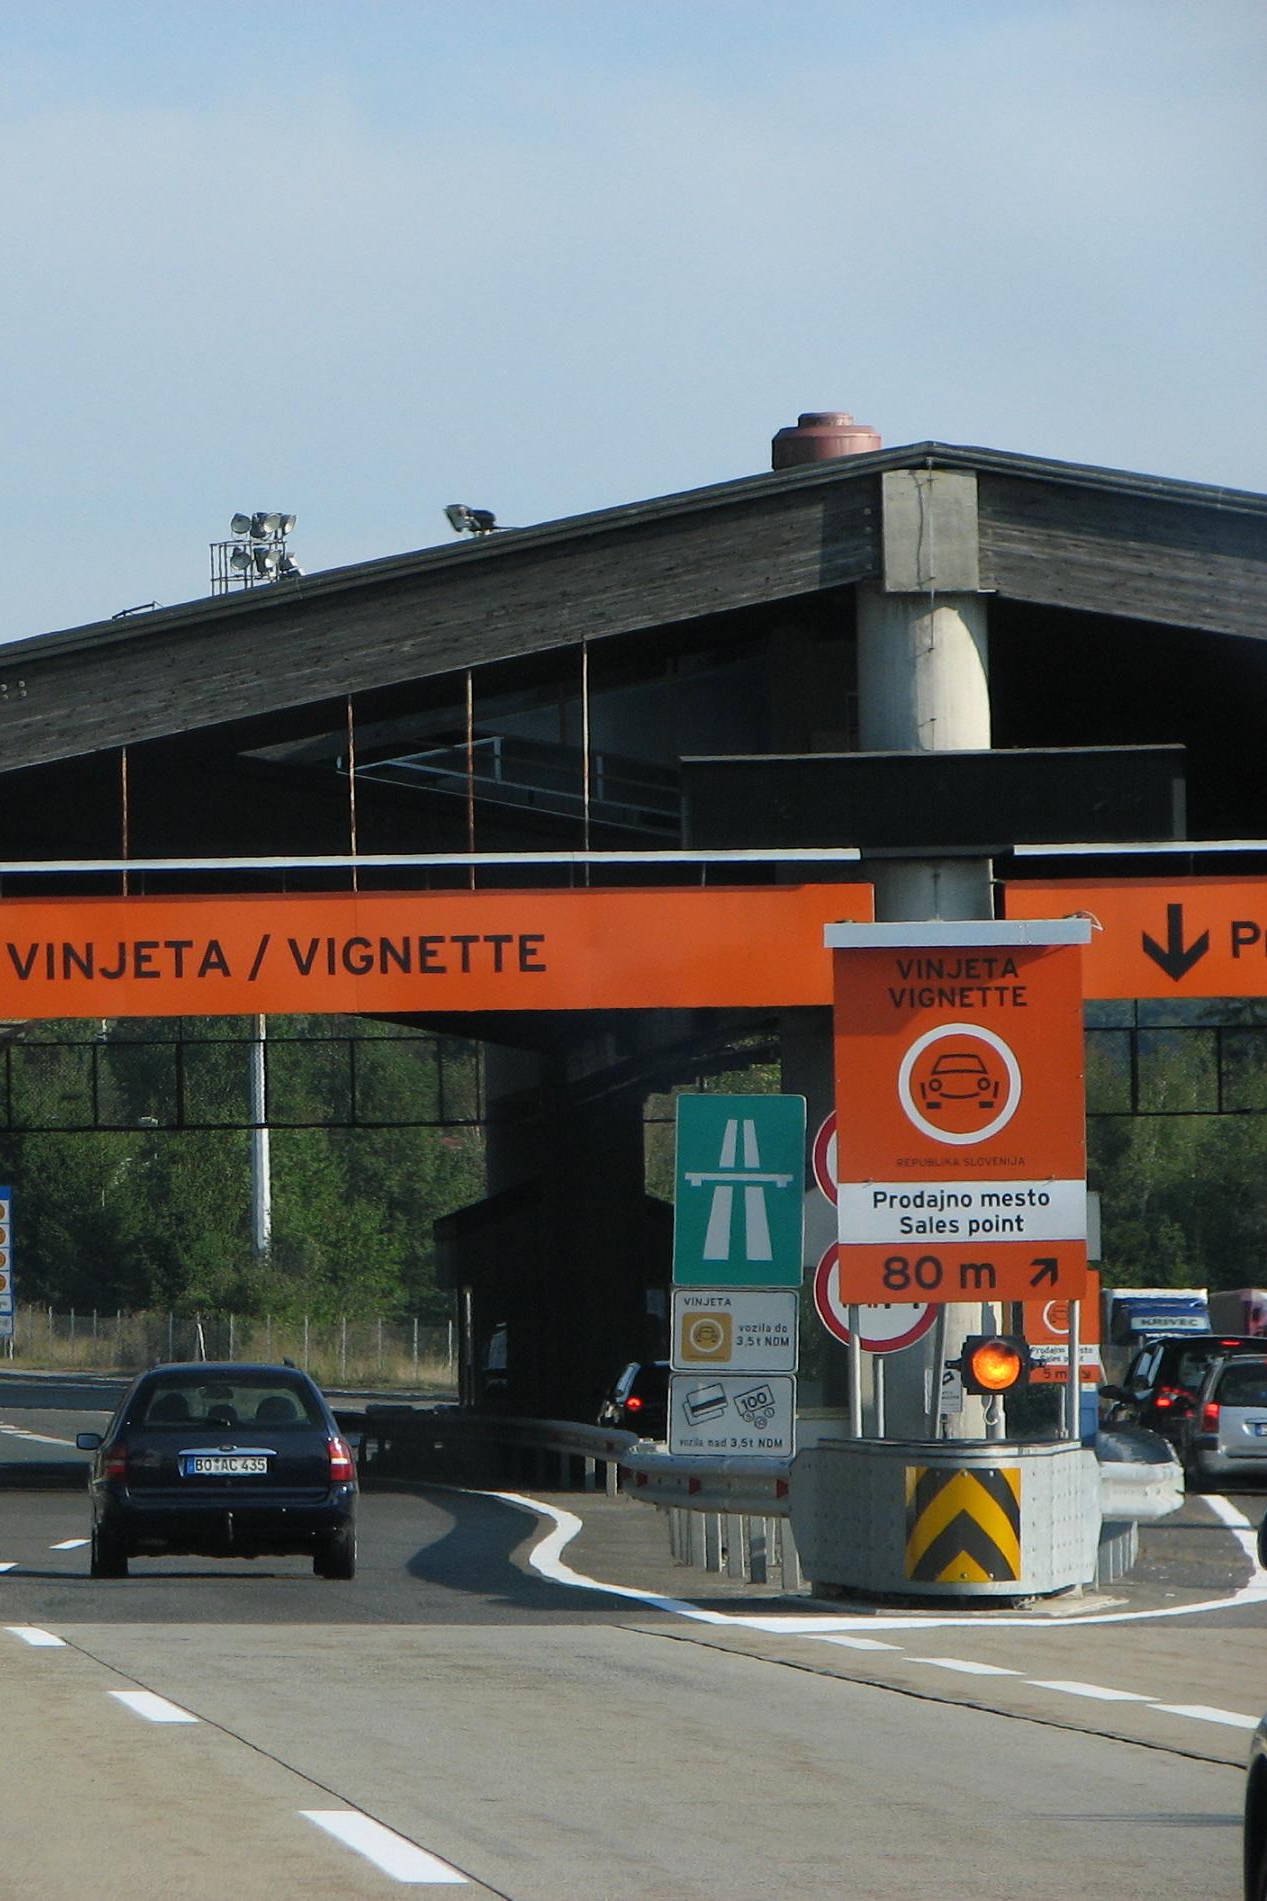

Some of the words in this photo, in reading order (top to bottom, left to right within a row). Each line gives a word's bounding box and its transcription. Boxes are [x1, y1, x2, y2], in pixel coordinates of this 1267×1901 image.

[1232, 920, 1267, 959] P
[6, 939, 232, 981] VINJETA
[287, 933, 547, 976] VIGNETTE
[895, 957, 1020, 980] VINJETA
[888, 985, 1028, 1009] VIGNETTE
[896, 1157, 960, 1168] REPUBLIKA
[963, 1156, 1026, 1168] SLOVENIJA
[872, 1189, 973, 1212] Prodajno
[981, 1188, 1051, 1208] mesto
[899, 1215, 960, 1235] Sales
[968, 1214, 1025, 1237] point
[883, 1255, 944, 1291] 80
[959, 1262, 997, 1290] m
[683, 1297, 732, 1307] VINJETA
[739, 1322, 772, 1333] vozila
[775, 1322, 788, 1333] do
[764, 1336, 790, 1347] NDM
[741, 1392, 767, 1410] 100
[679, 1438, 704, 1448] vozila
[708, 1437, 727, 1448] nad
[758, 1438, 783, 1448] NDM
[195, 1459, 213, 1472] BO
[241, 1458, 266, 1472] 435
